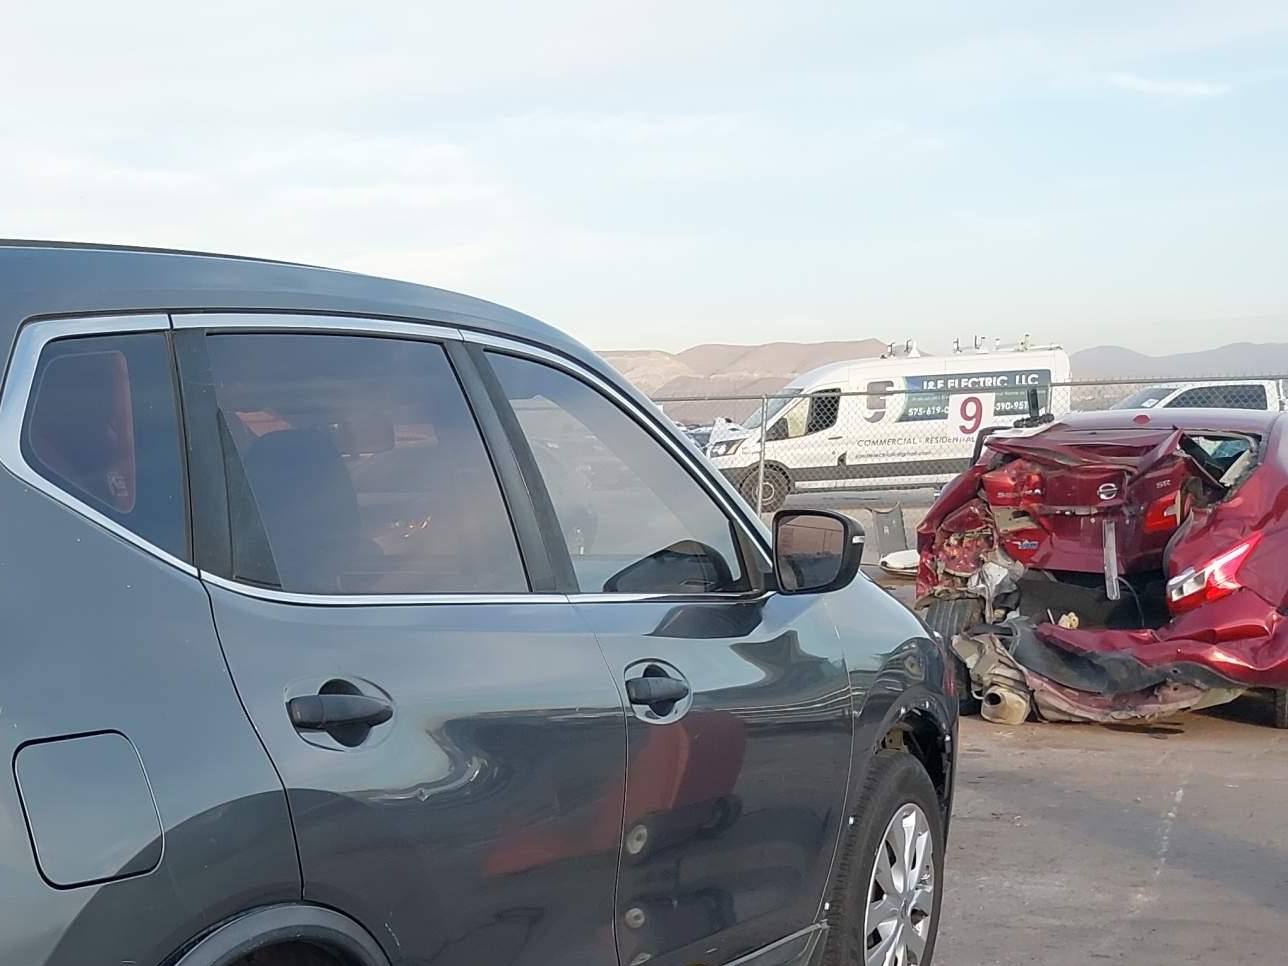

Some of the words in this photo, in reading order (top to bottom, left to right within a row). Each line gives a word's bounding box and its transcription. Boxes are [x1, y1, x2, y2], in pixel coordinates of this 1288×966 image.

[947, 376, 1008, 389] ELECTRIC
[1016, 374, 1039, 385] LLC
[908, 406, 949, 416] 575-619-0
[959, 396, 983, 435] 9
[856, 438, 918, 447] COMMERCIAL
